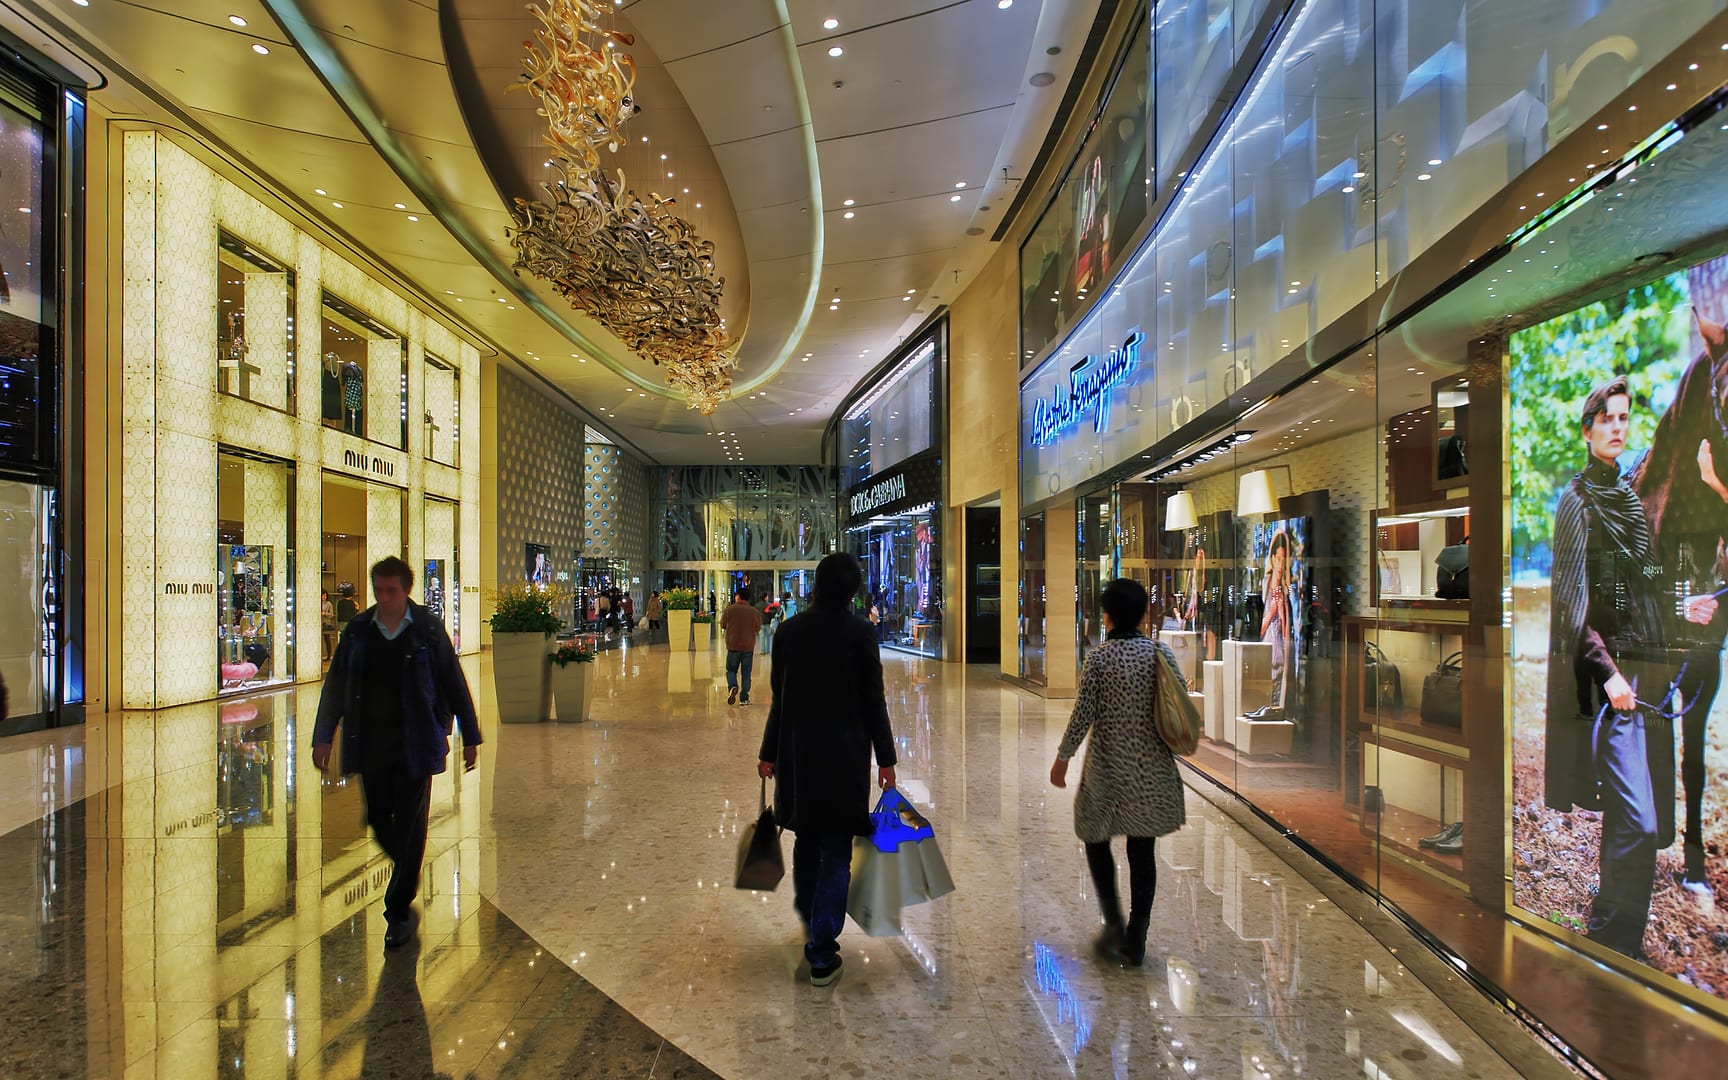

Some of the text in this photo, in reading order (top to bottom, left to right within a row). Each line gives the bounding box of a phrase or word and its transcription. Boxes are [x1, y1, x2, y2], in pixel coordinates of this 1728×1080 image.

[344, 449, 394, 477] MIU MIU
[165, 582, 213, 594] MIU MIU
